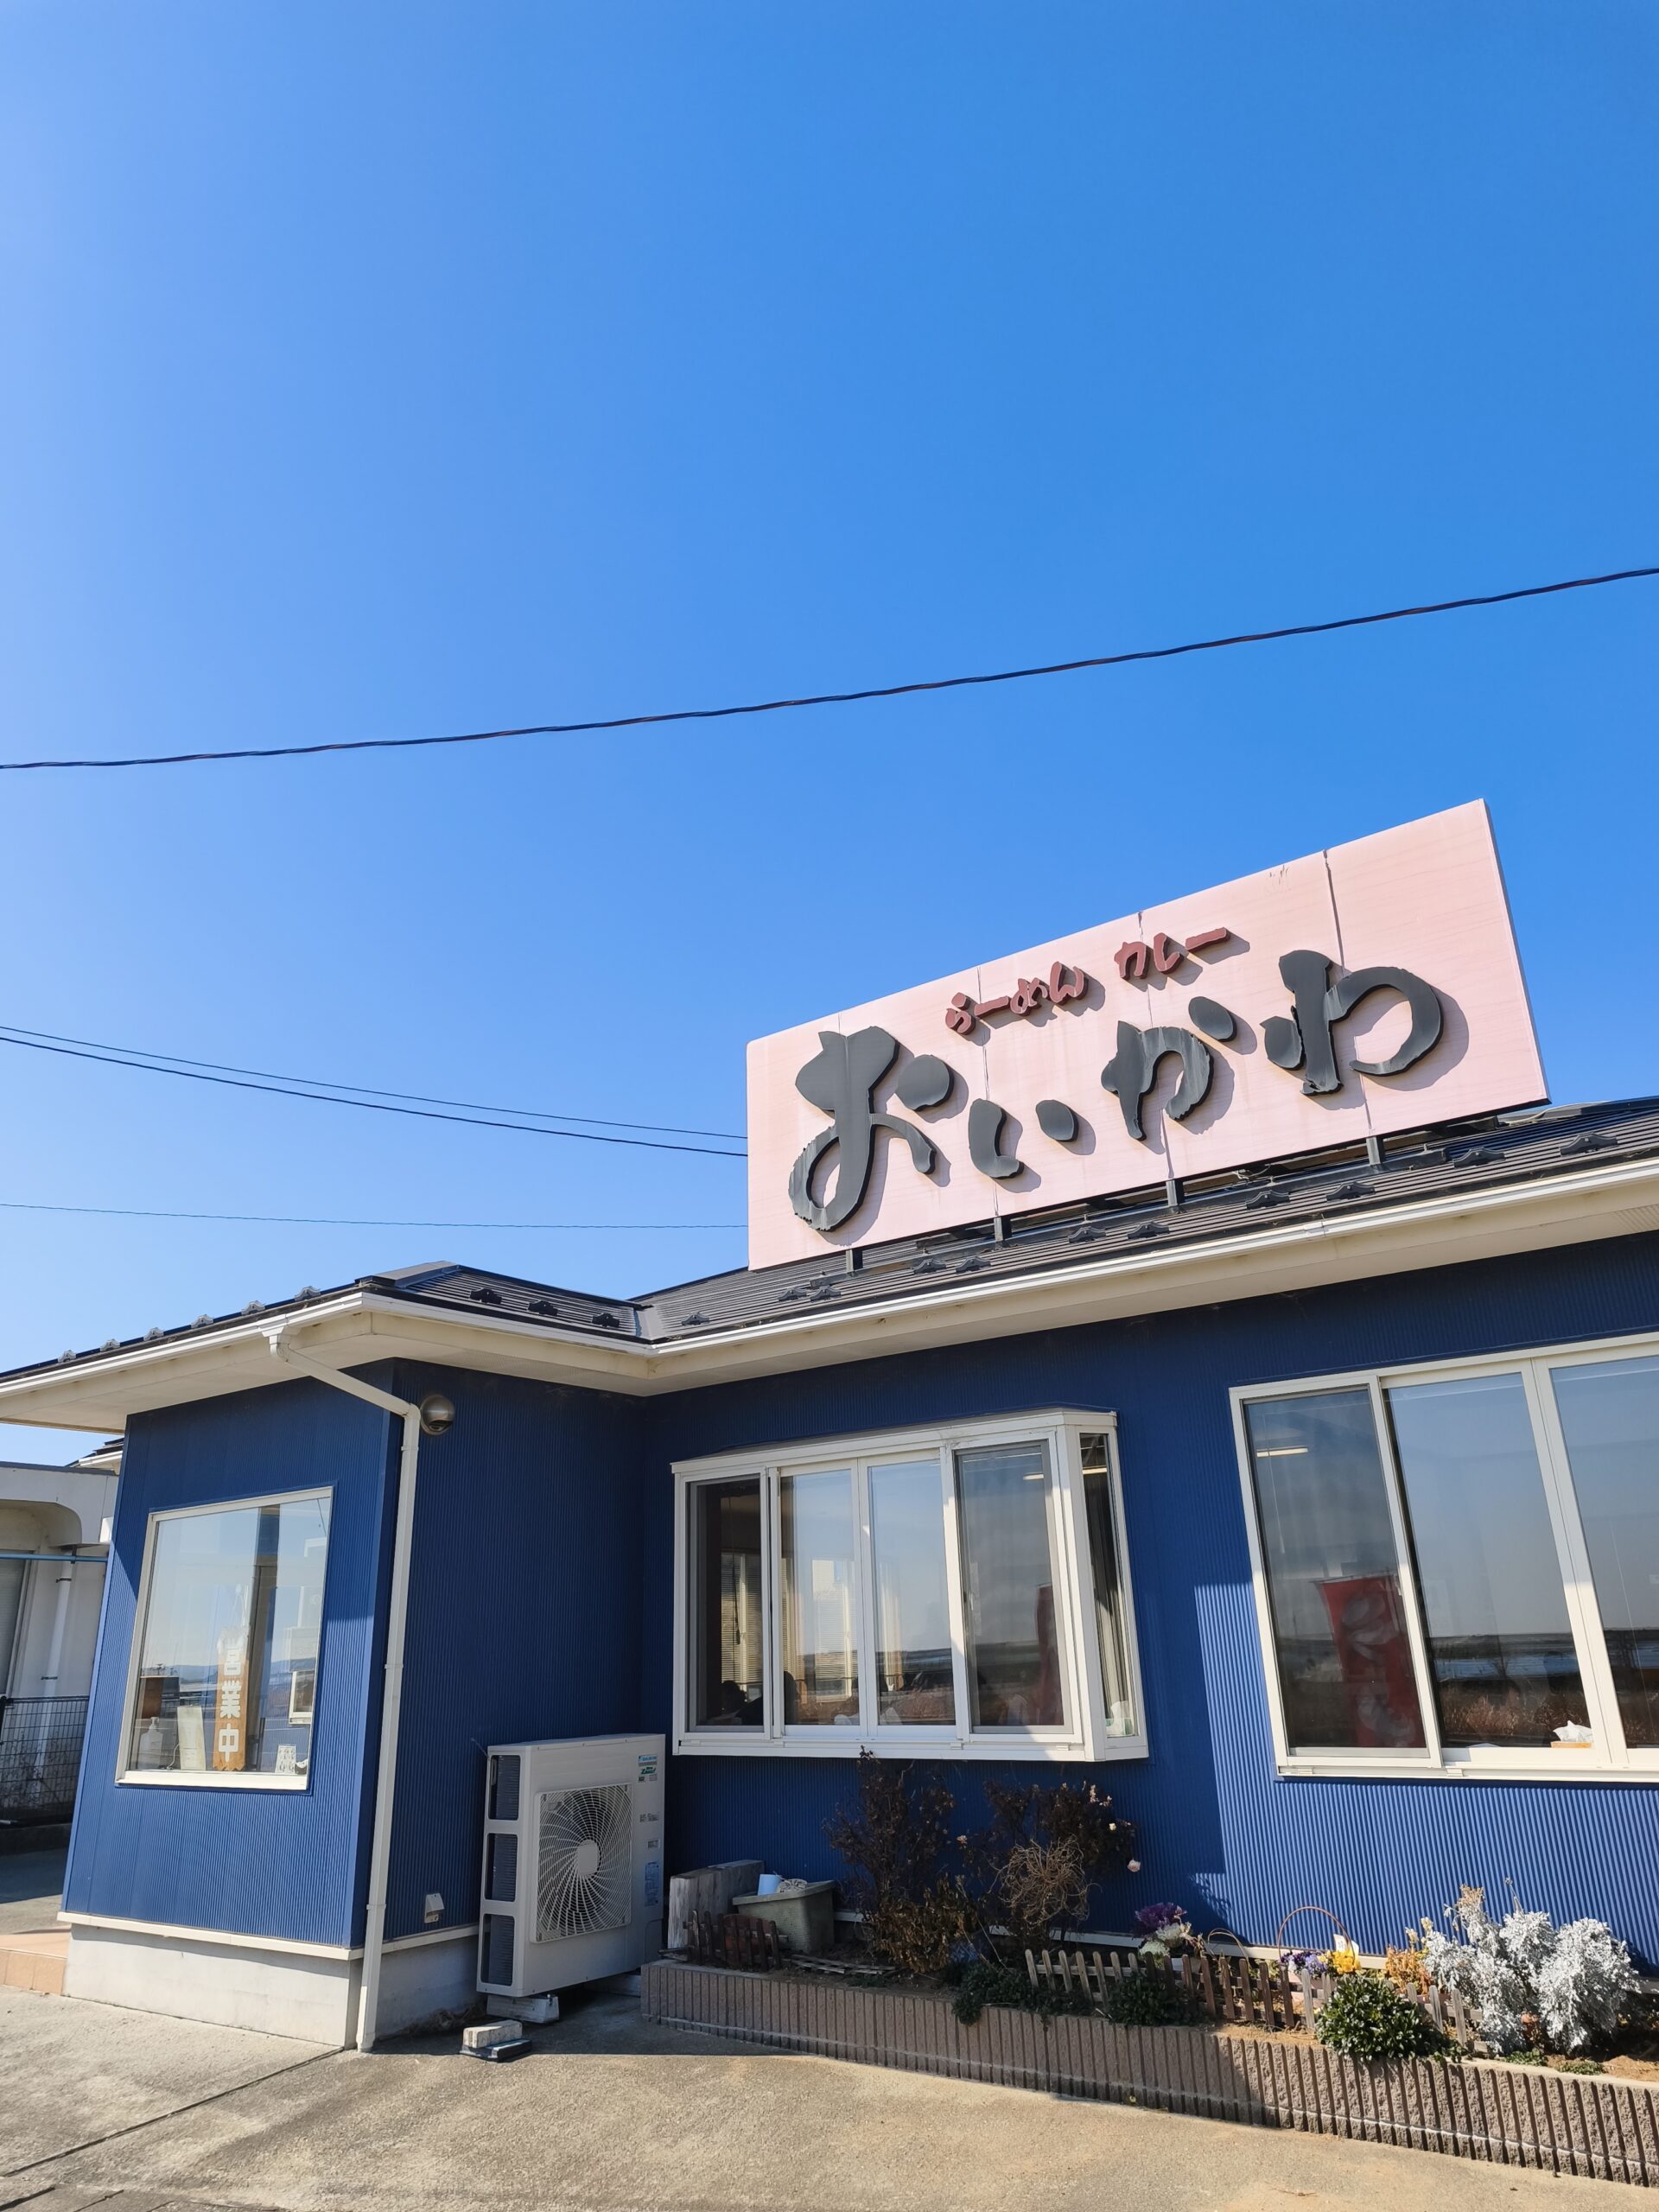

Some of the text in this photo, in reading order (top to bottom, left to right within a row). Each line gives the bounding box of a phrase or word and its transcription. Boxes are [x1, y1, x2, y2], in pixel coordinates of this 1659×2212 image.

[945, 927, 1231, 1036] らーめん カレー
[788, 949, 1445, 1233] おいかわ
[218, 1639, 242, 1763] 営業中
